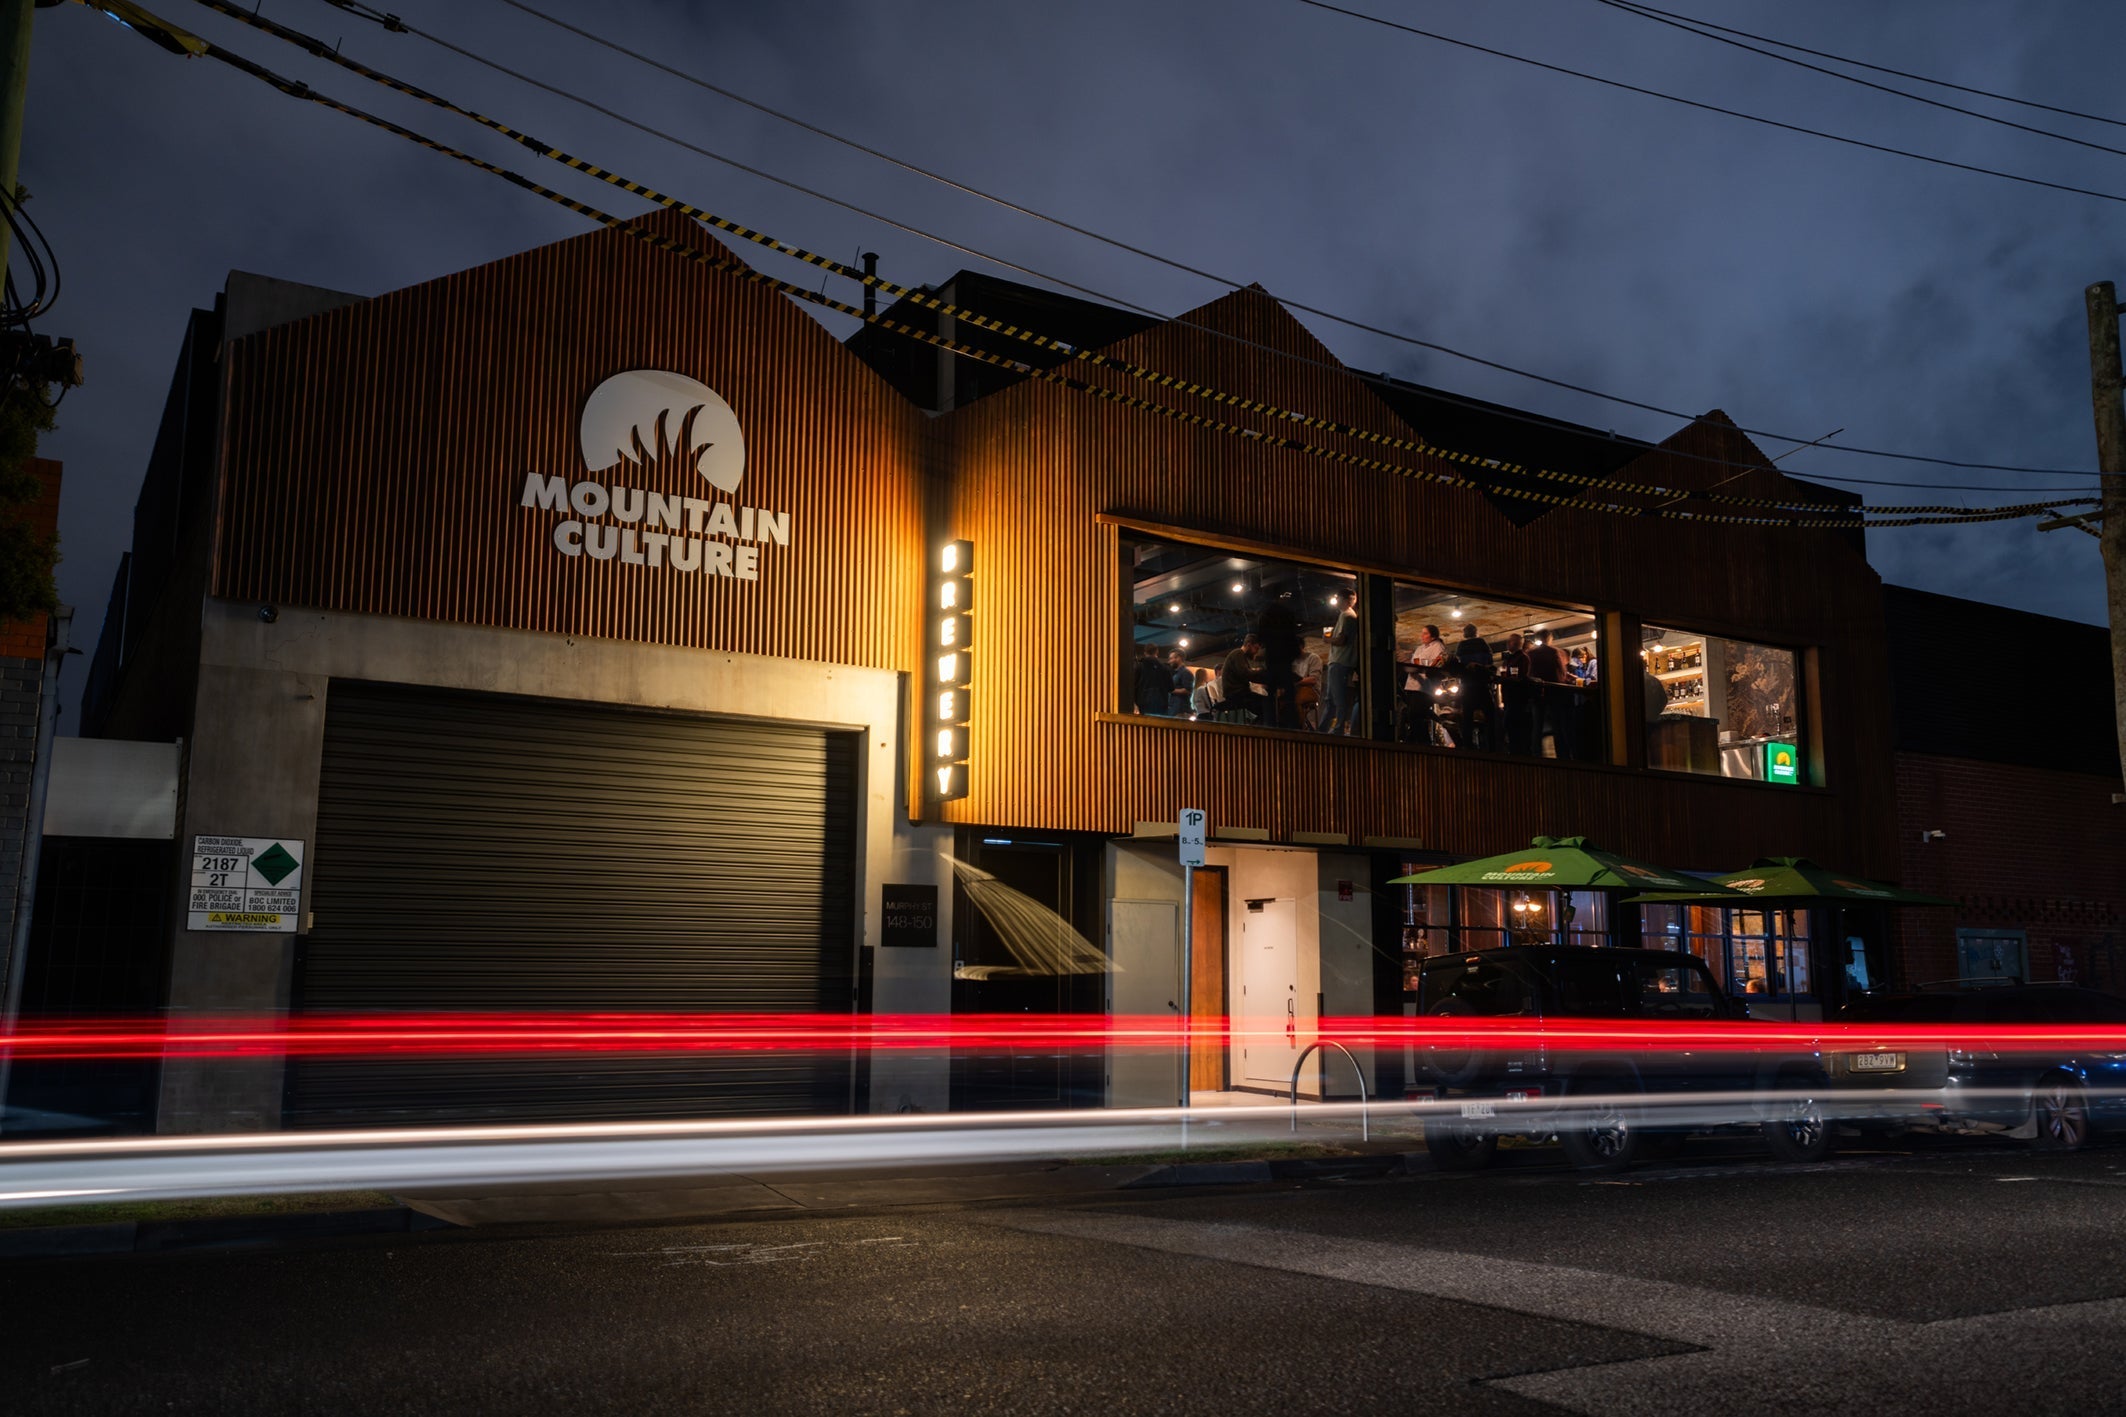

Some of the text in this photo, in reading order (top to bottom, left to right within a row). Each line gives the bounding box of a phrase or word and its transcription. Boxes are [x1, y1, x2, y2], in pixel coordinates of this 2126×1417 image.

[521, 472, 790, 546] MOUNTAIN
[554, 521, 758, 581] CULTURE
[1186, 813, 1203, 826] 1P
[197, 837, 220, 845] CARBON
[197, 846, 255, 856] REFRIGERATED LIQUID
[202, 857, 239, 871] 2187
[209, 873, 229, 886] 2T
[208, 894, 232, 902] POLICE
[249, 897, 264, 905] BOC
[192, 902, 241, 911] FIRE BRIGADE
[886, 901, 920, 911] MURPHY
[226, 914, 277, 923] WARNING
[886, 915, 933, 929] 148-150
